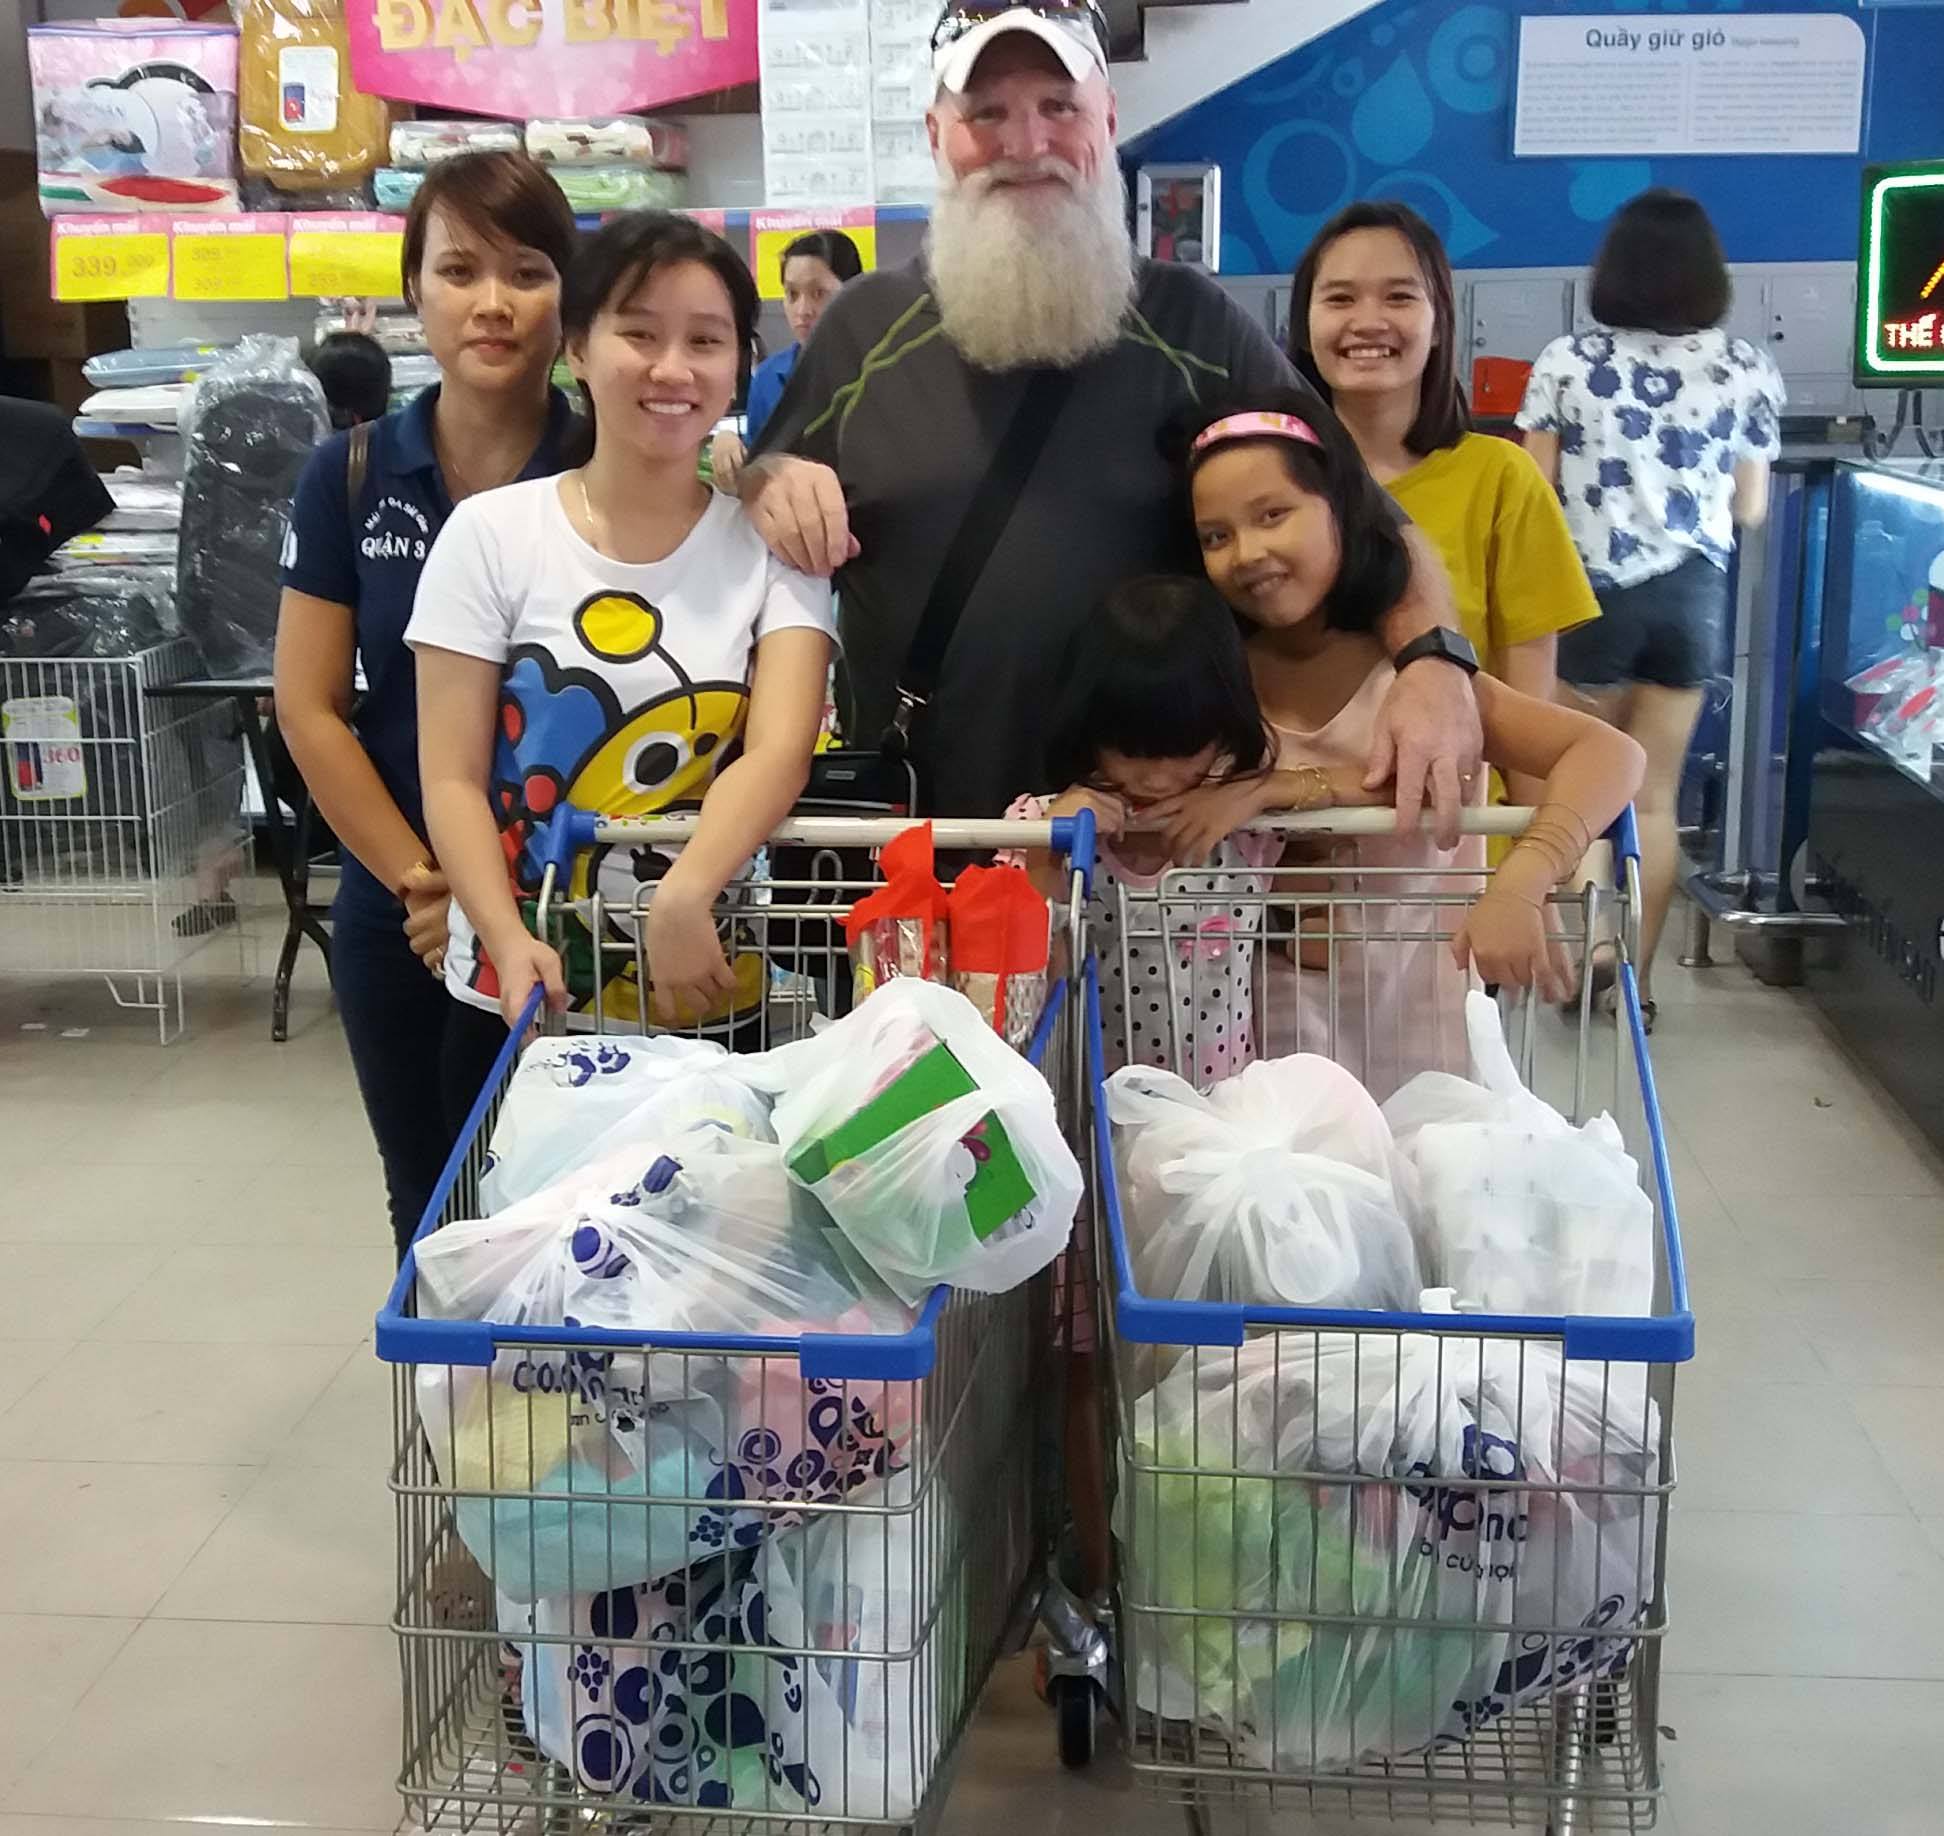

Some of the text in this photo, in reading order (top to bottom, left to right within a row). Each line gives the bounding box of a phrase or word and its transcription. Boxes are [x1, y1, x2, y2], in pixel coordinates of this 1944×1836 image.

[1586, 28, 1641, 51] Quầy
[360, 531, 426, 561] QUẬN 3
